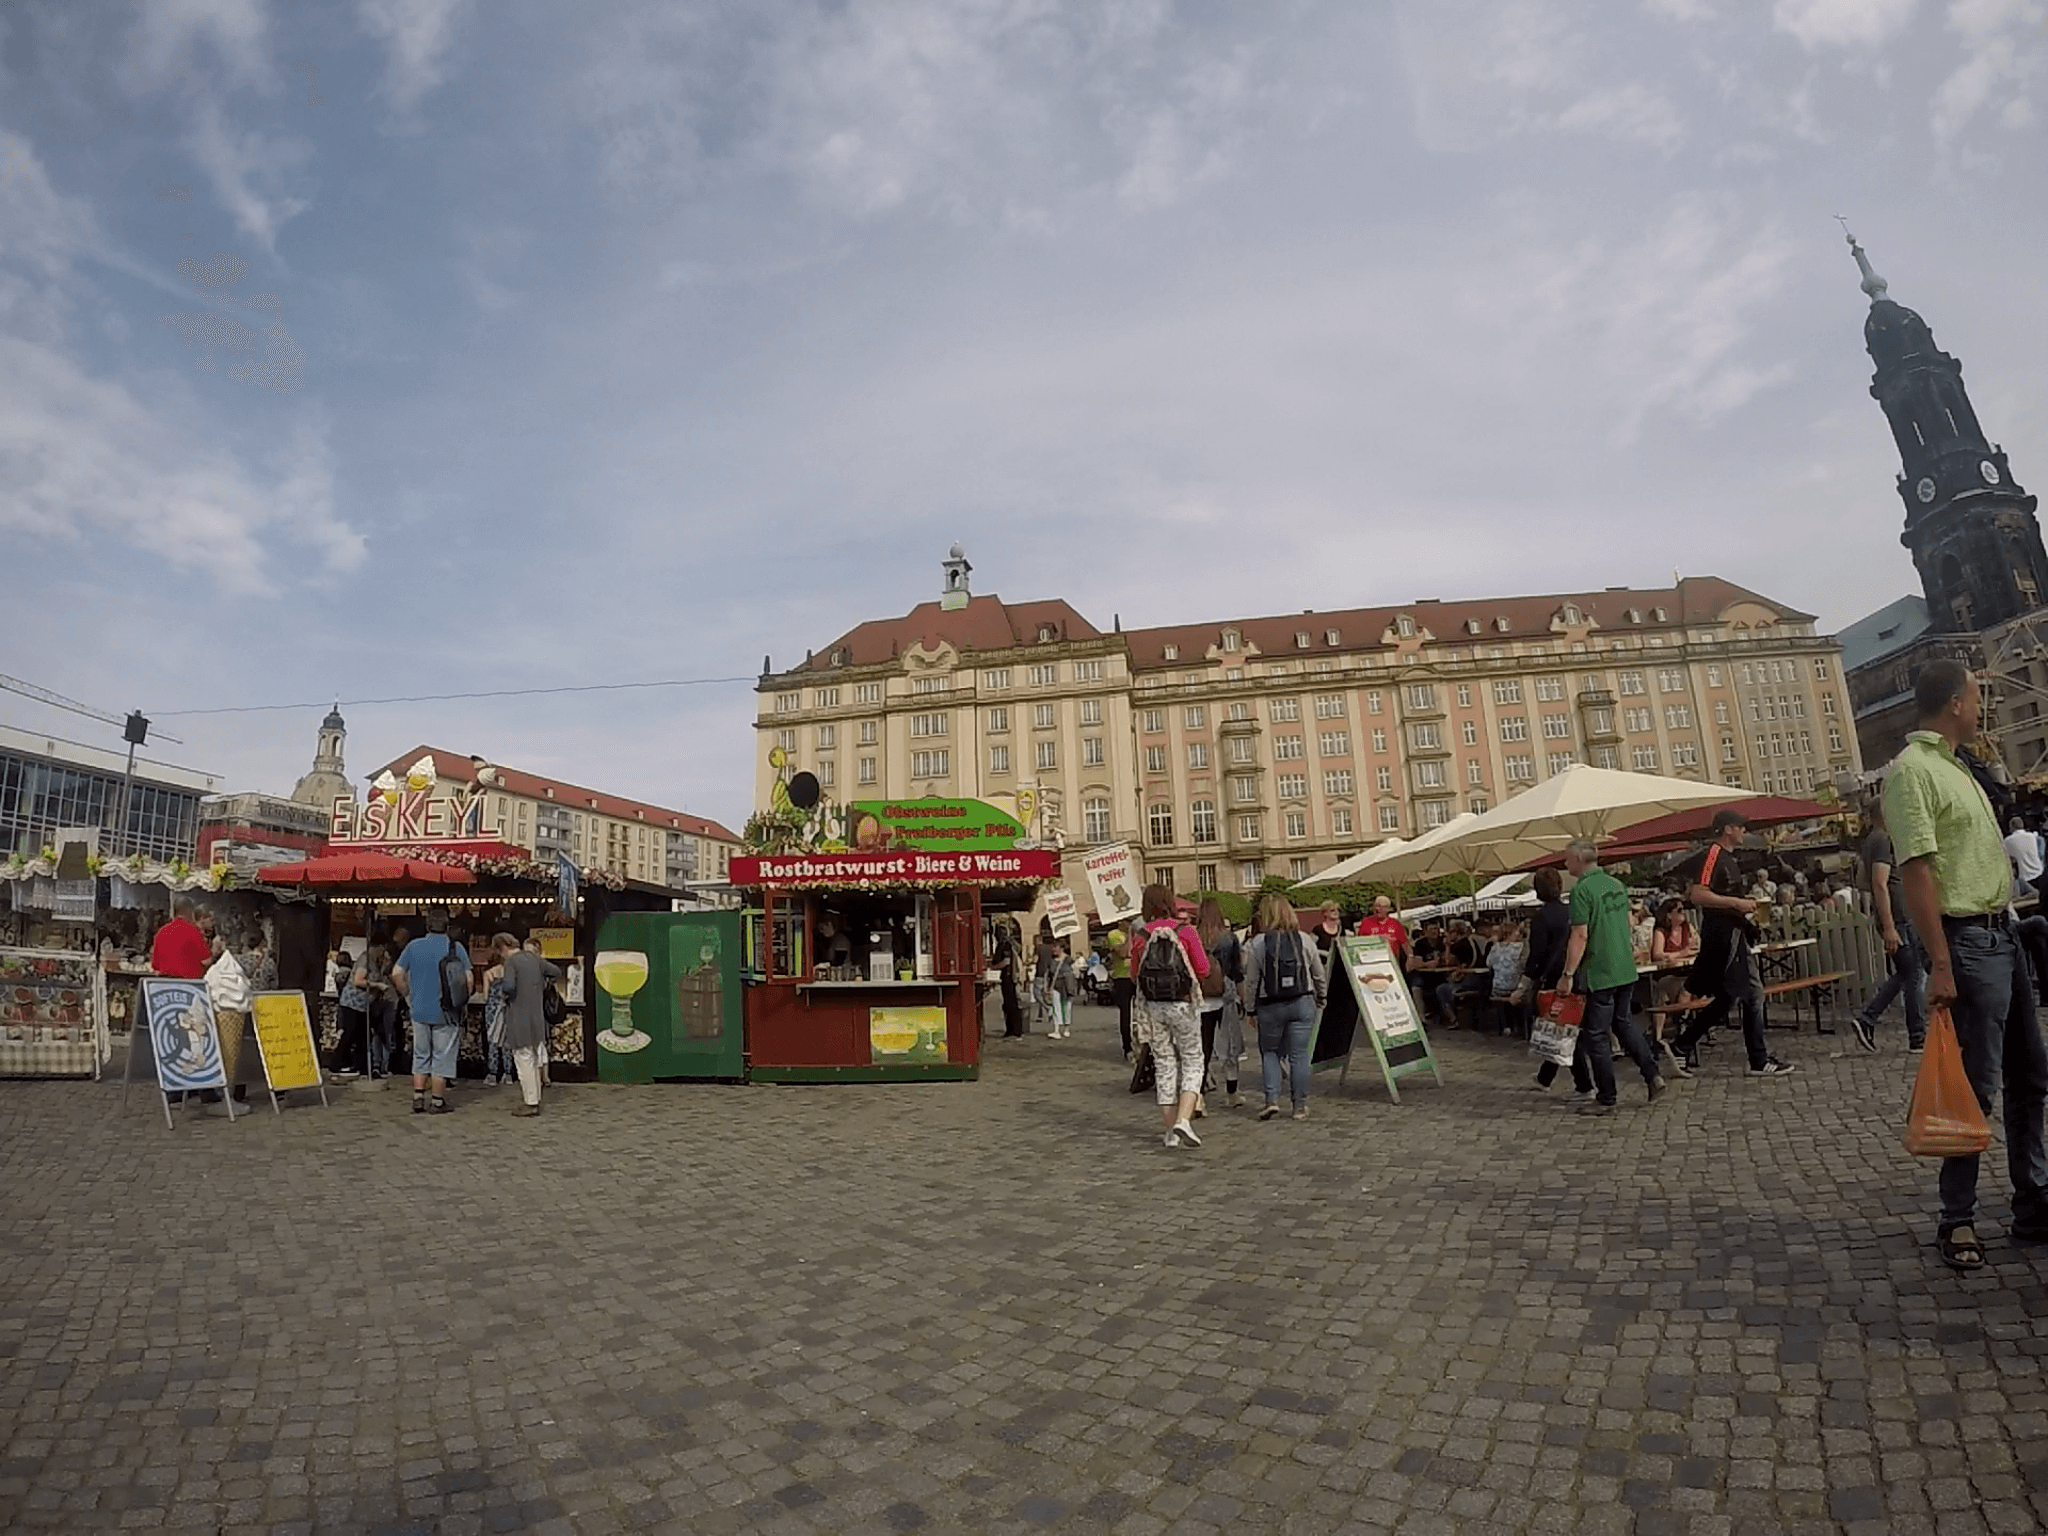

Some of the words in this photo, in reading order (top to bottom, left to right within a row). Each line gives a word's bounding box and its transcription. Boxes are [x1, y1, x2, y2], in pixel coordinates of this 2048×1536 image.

[759, 859, 906, 878] Rostbratwurst
[915, 856, 956, 873] Biere
[958, 855, 972, 871] &
[974, 855, 1021, 872] Weine
